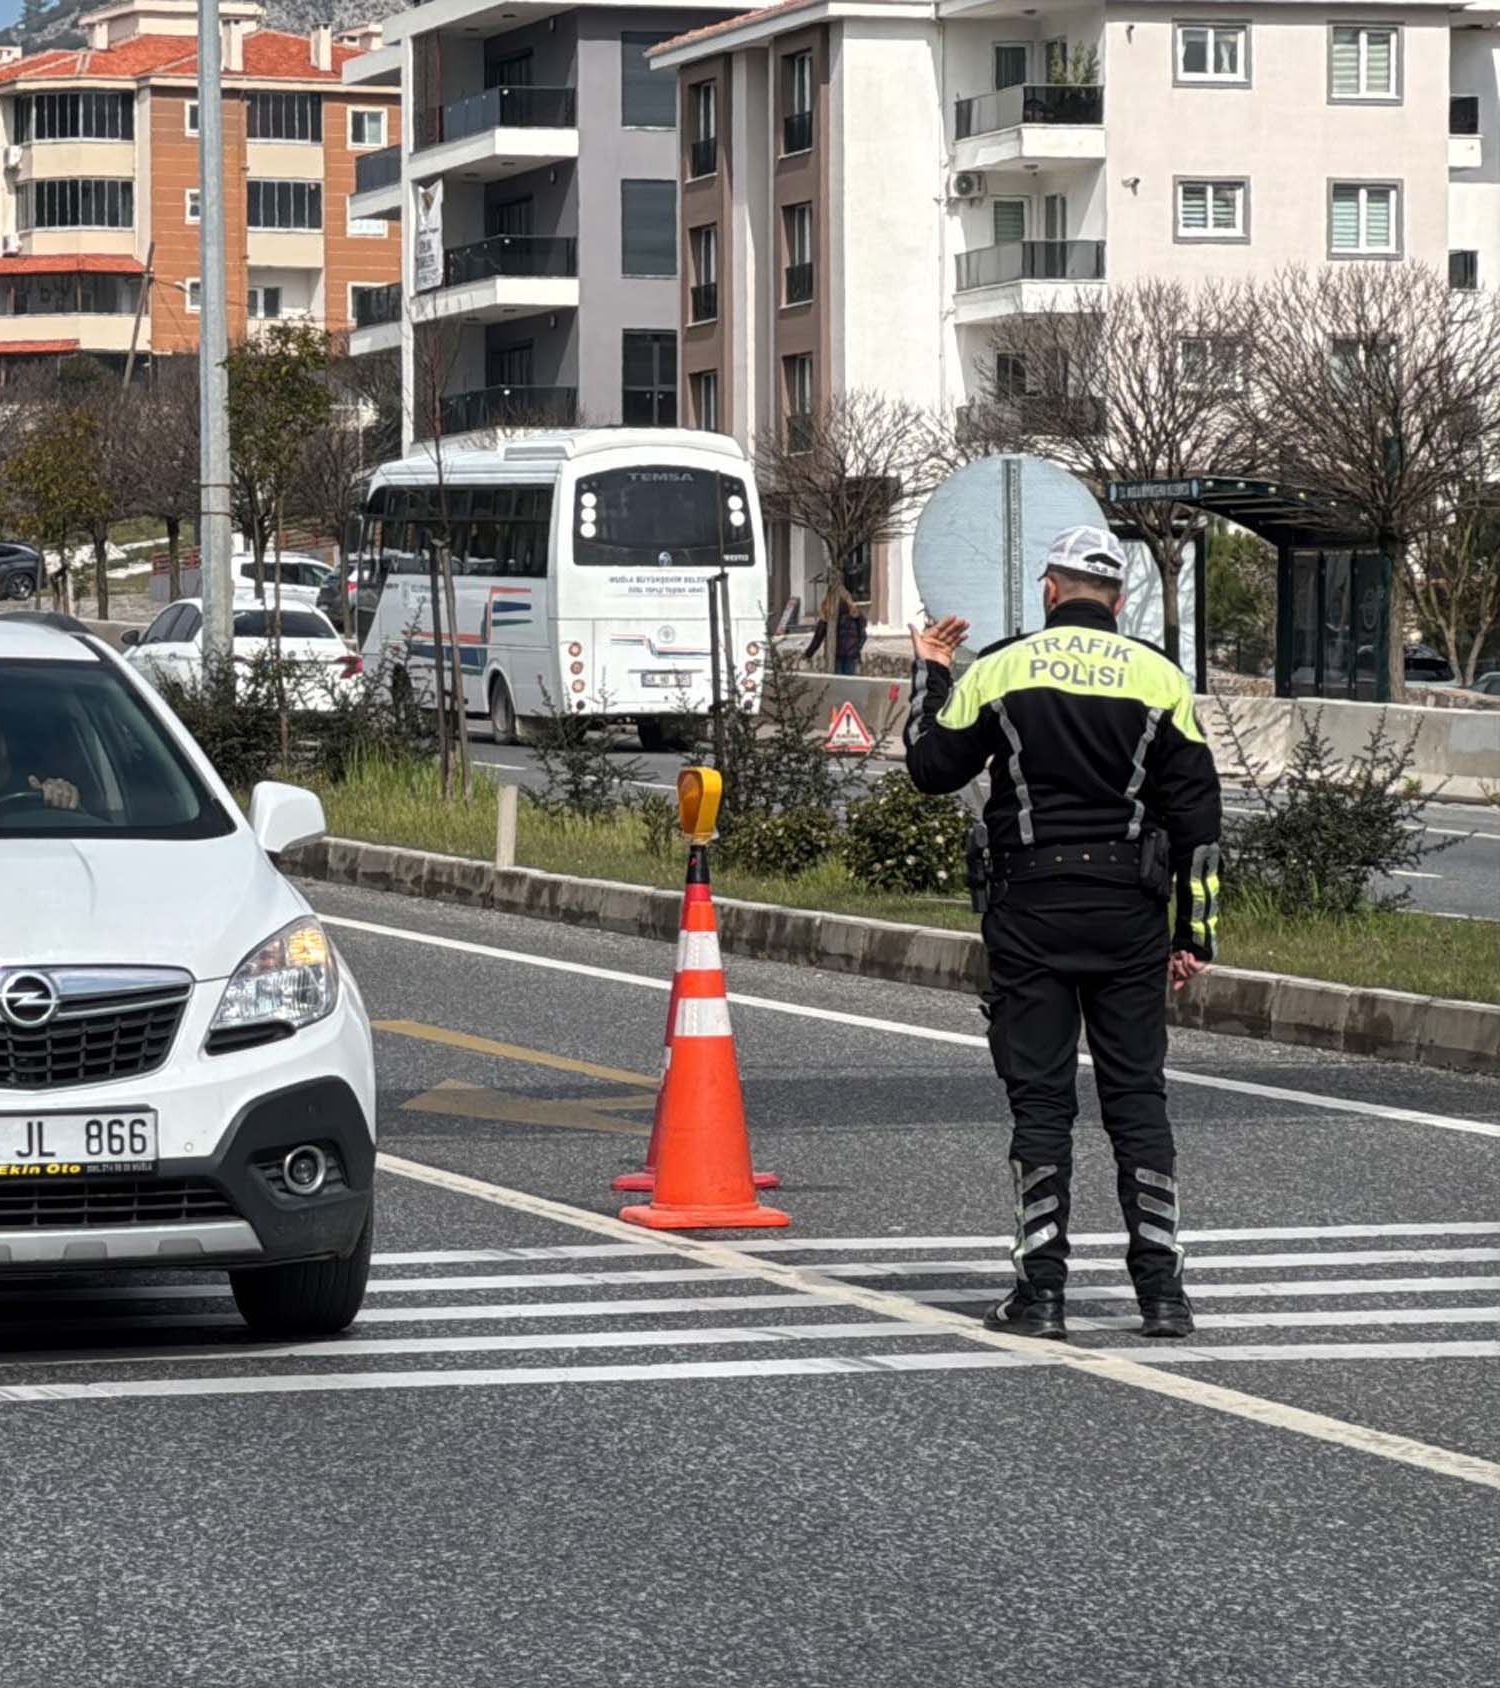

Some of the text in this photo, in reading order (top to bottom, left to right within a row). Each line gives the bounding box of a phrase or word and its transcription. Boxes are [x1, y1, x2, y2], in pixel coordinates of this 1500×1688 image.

[628, 472, 694, 482] TEMSA
[16, 1121, 56, 1157] JL
[85, 1119, 147, 1155] 866
[46, 1162, 81, 1175] Oto
